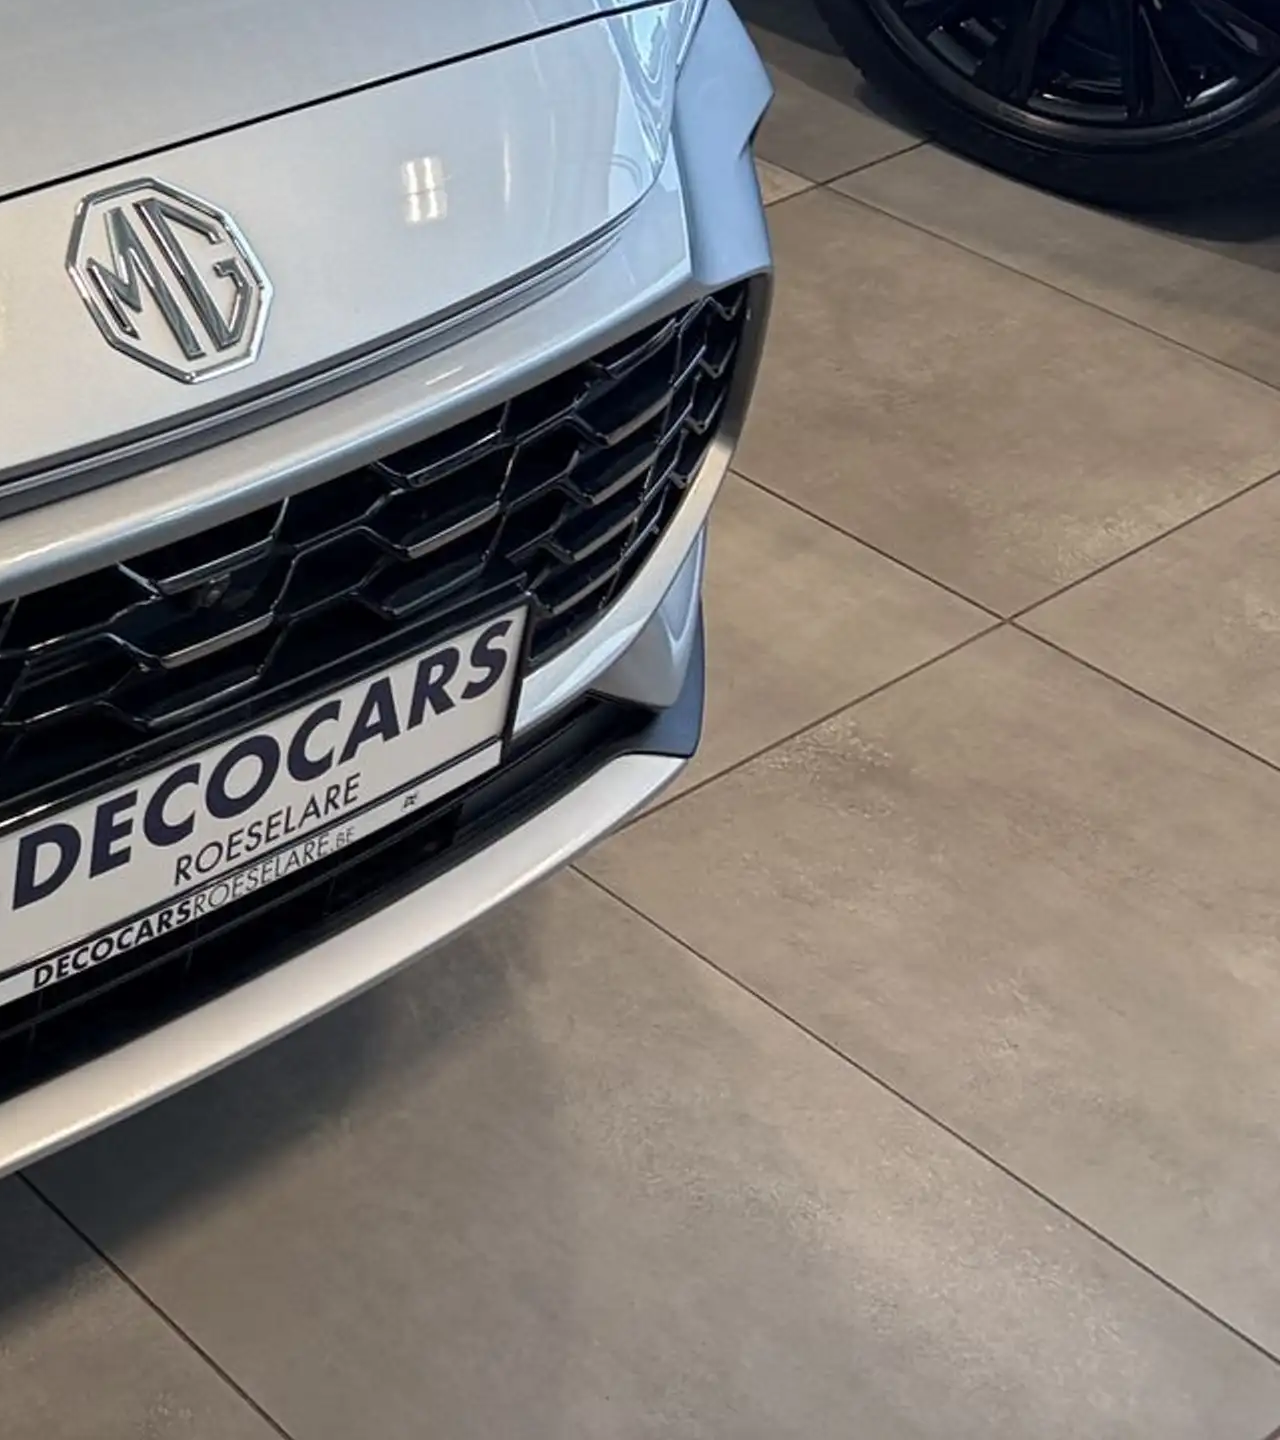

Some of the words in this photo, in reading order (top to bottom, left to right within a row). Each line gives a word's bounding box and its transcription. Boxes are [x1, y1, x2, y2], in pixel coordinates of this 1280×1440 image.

[85, 197, 253, 361] MG
[12, 619, 514, 911] DECOCARS
[173, 772, 362, 887] ROESELARE
